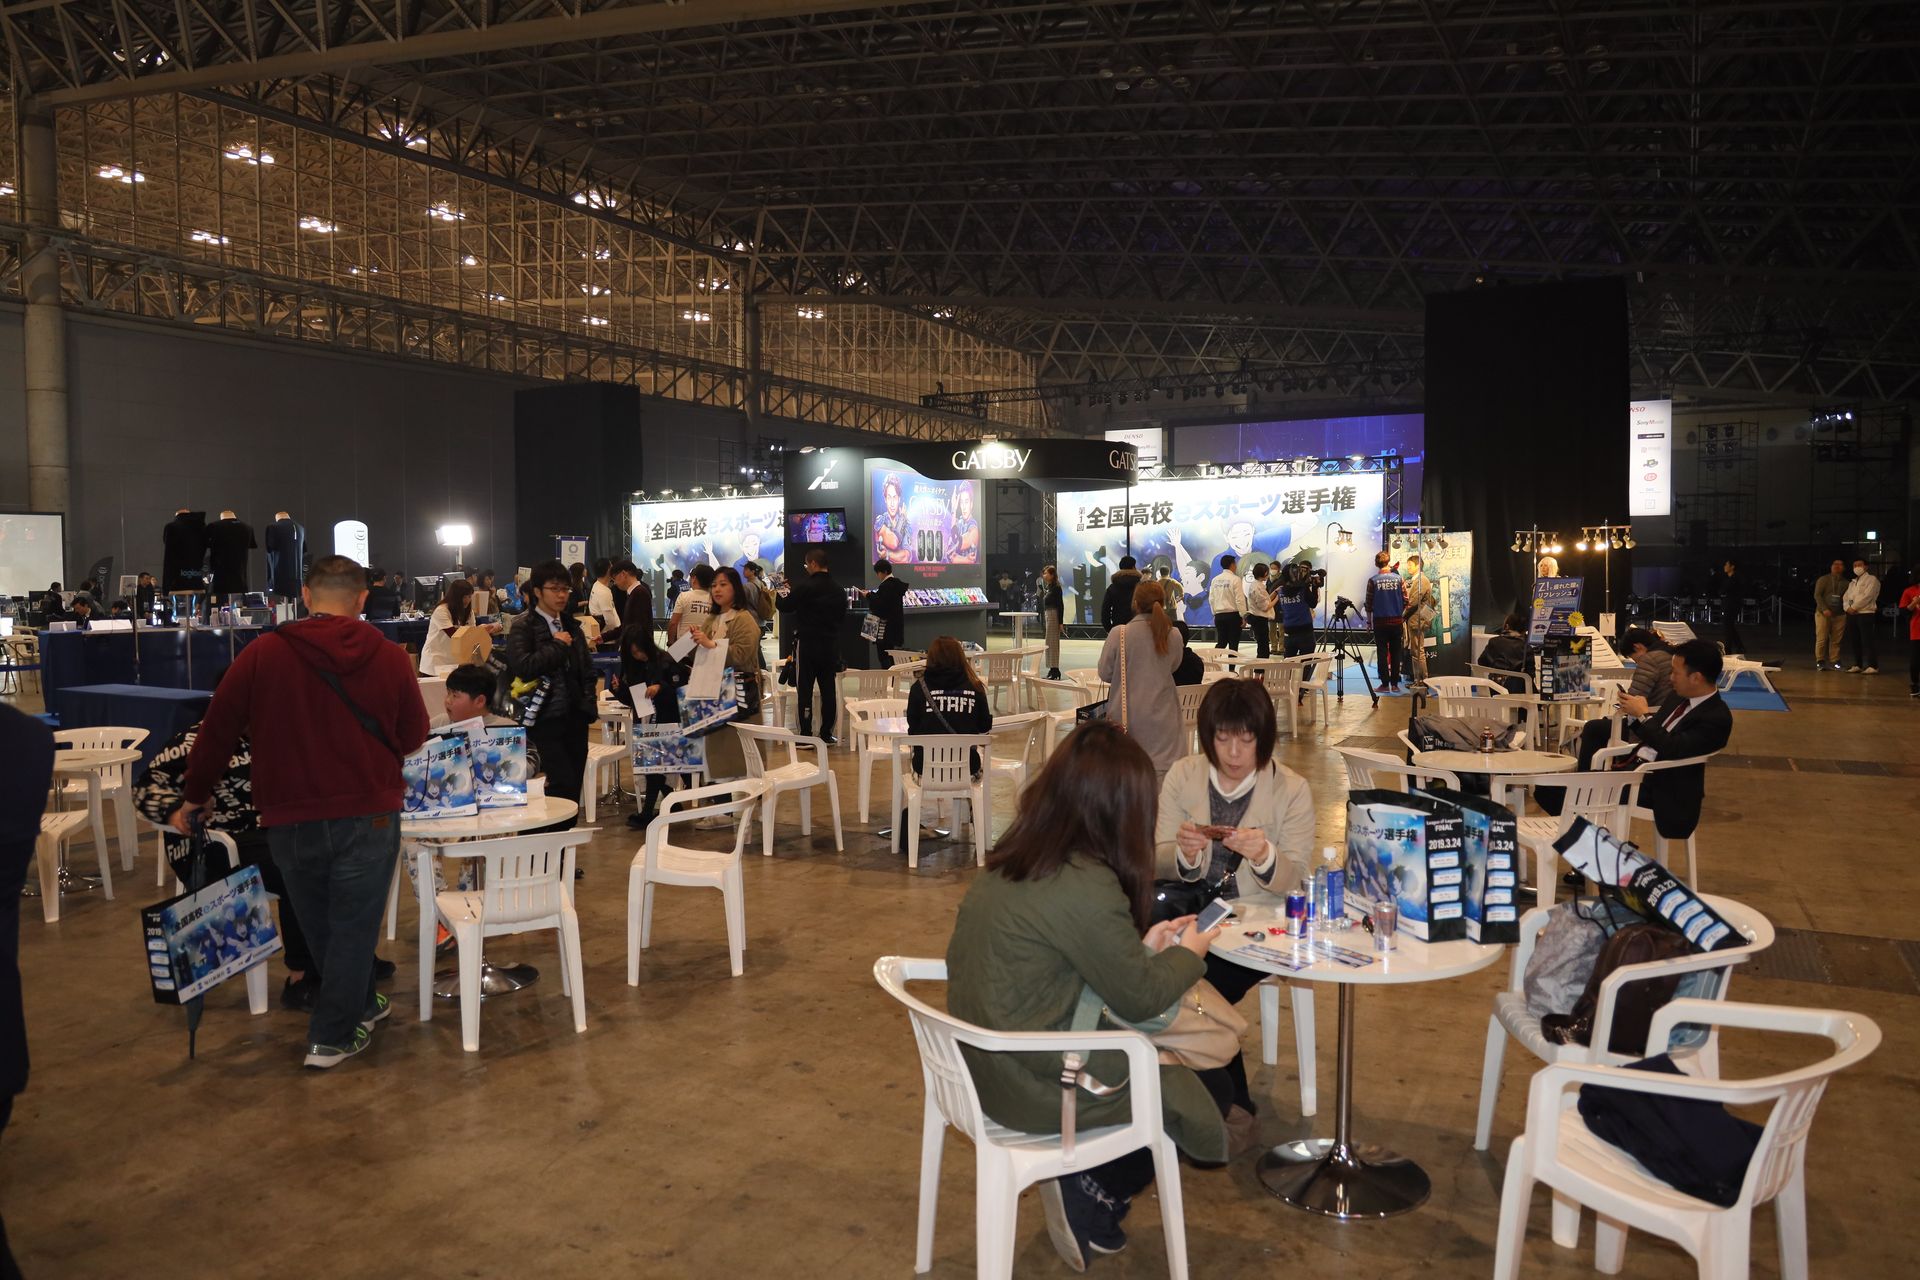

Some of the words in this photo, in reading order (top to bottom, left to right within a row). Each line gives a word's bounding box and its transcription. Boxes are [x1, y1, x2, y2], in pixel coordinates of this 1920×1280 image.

[951, 448, 1032, 472] GATSBY
[1086, 485, 1357, 531] 全国高校eスポーツ選手権
[1376, 582, 1399, 592] PRESS
[1538, 588, 1577, 599] リフレッシュ!
[1279, 594, 1301, 606] PRESS
[1434, 823, 1454, 832] FINAL
[1428, 837, 1462, 851] 2019.3.24
